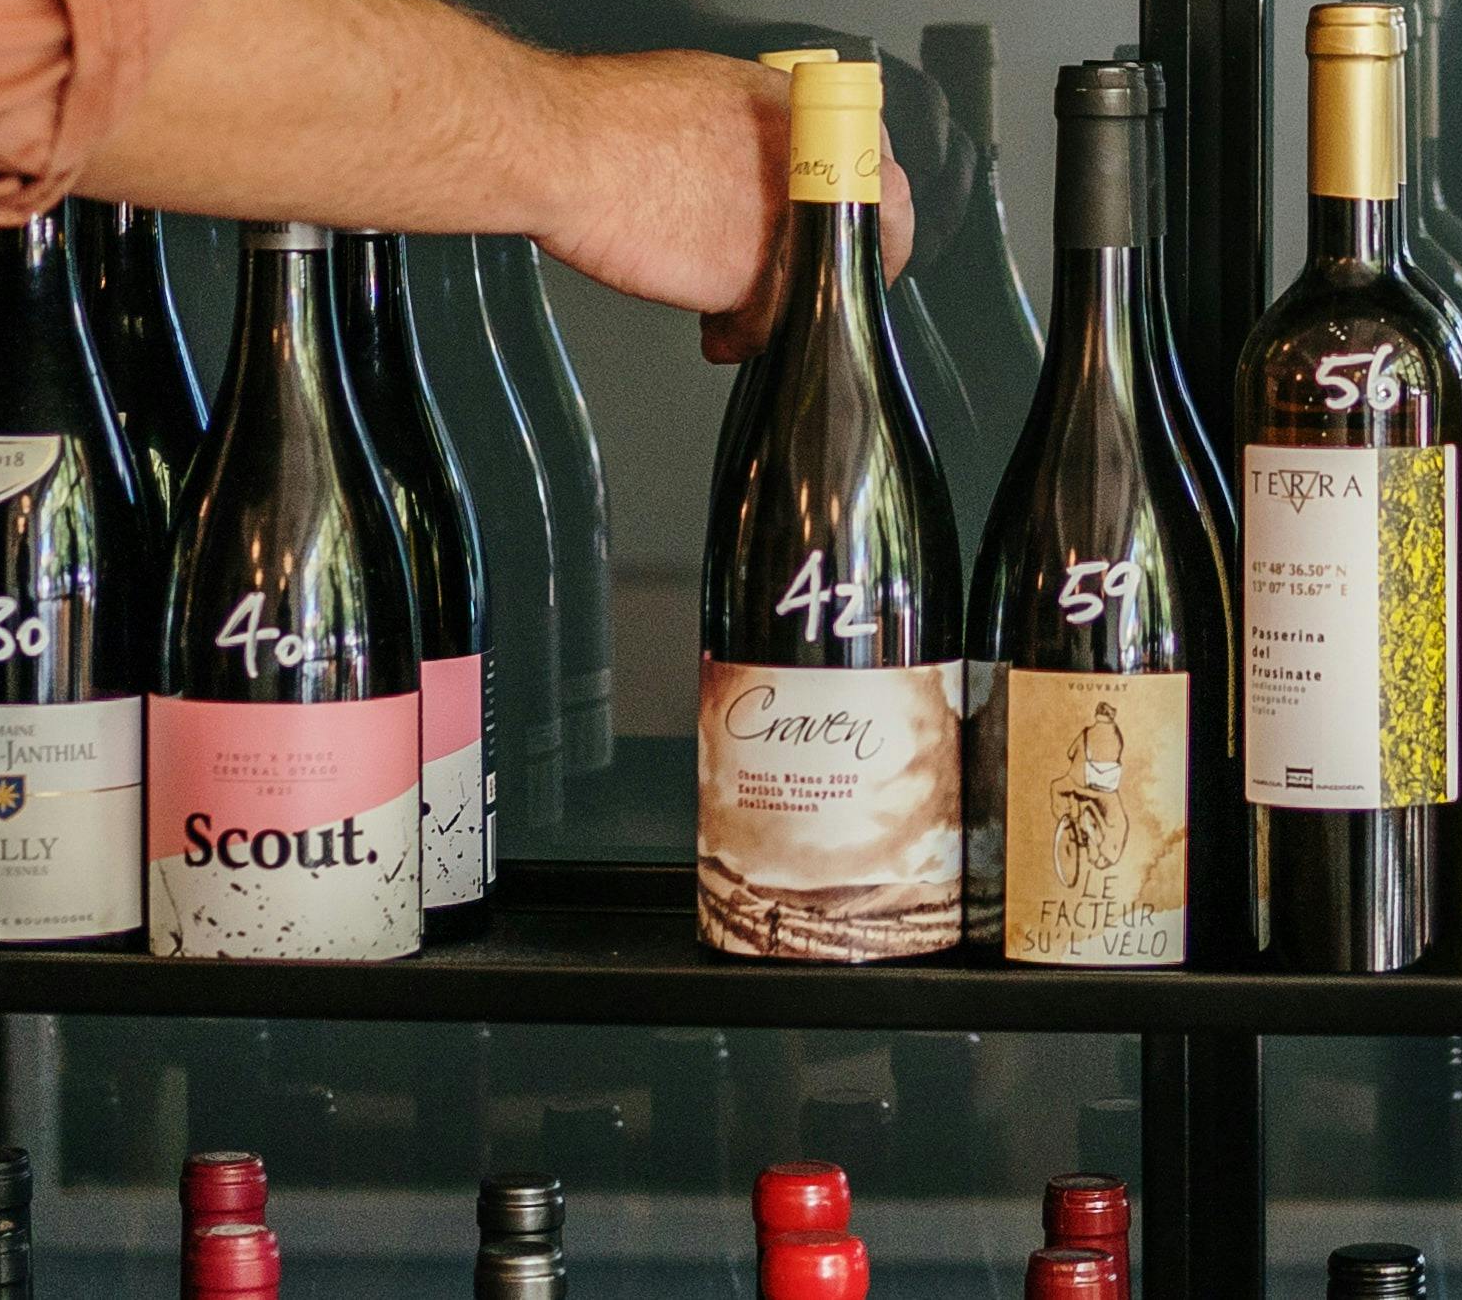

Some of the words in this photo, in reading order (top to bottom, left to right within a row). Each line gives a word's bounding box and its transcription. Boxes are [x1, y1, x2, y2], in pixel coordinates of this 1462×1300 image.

[1315, 344, 1399, 411] 56
[1251, 470, 1363, 499] TERRA
[775, 549, 877, 642] 42
[1058, 561, 1141, 651] 59
[216, 592, 306, 679] 40
[1251, 626, 1326, 643] Passerina
[1251, 645, 1271, 659] del
[1251, 665, 1322, 682] Frusinate
[725, 685, 885, 760] Craven
[183, 812, 378, 871] Scout.
[1080, 876, 1115, 901] LE
[1040, 902, 1156, 929] FACTEUR
